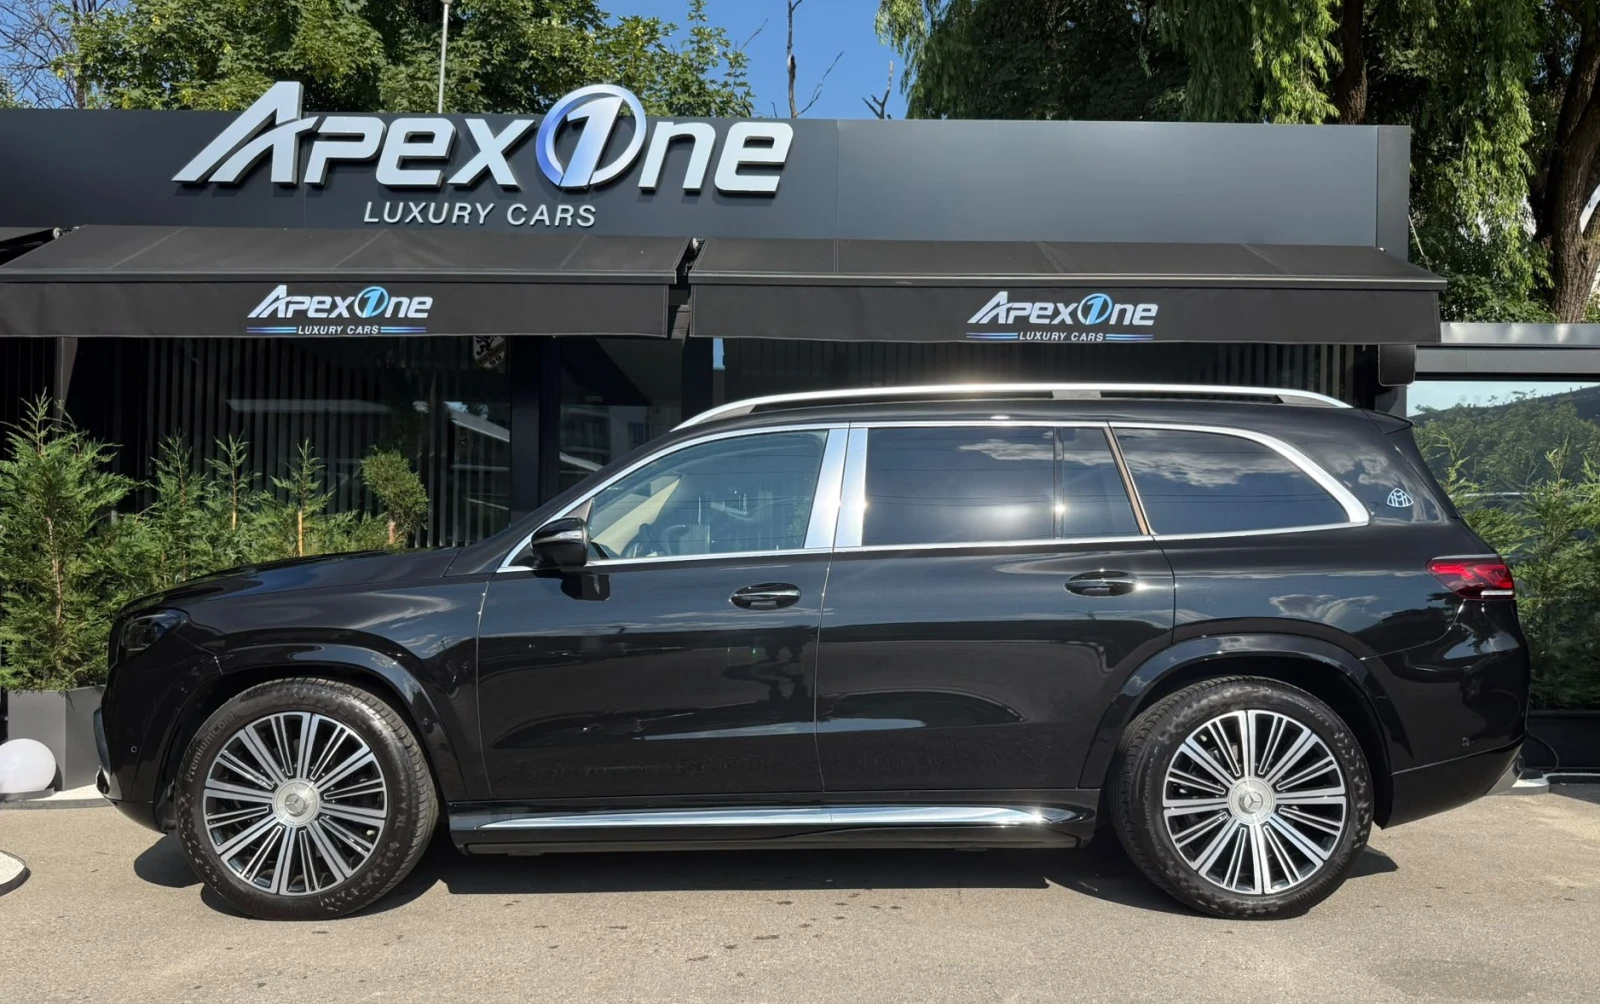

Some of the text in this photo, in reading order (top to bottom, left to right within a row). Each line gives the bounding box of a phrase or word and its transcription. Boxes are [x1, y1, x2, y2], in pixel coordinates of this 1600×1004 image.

[363, 201, 597, 228] LUXURY CARS
[298, 325, 380, 335] LUXURY CARS
[1019, 331, 1104, 342] LUXURY CARS
